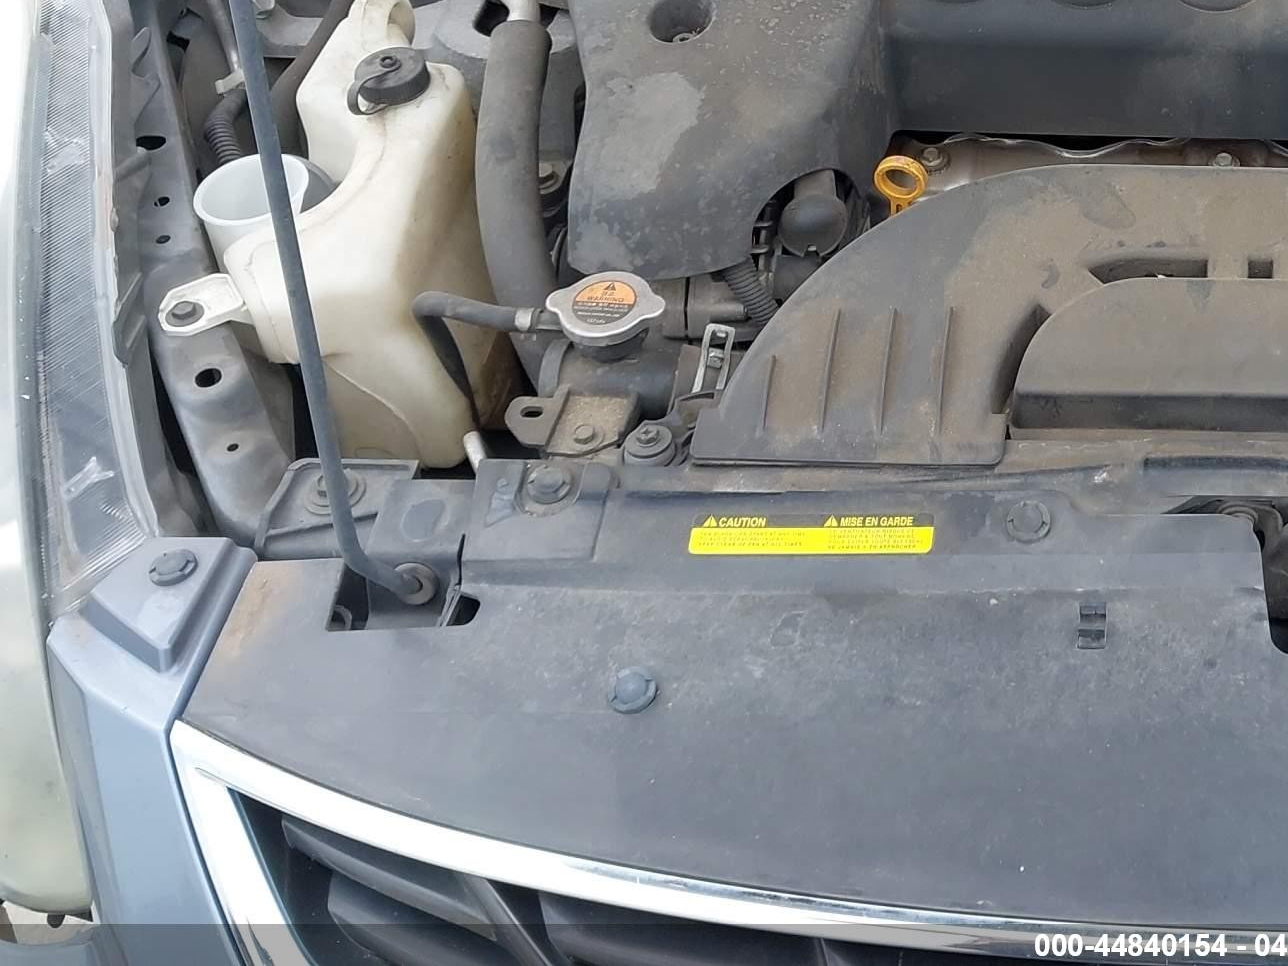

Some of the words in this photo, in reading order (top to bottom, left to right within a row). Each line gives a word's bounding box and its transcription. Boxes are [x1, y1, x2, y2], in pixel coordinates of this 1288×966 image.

[718, 516, 767, 528] CAUTION
[840, 516, 864, 527] MISE
[865, 516, 879, 527] EN
[880, 516, 914, 527] GARDE
